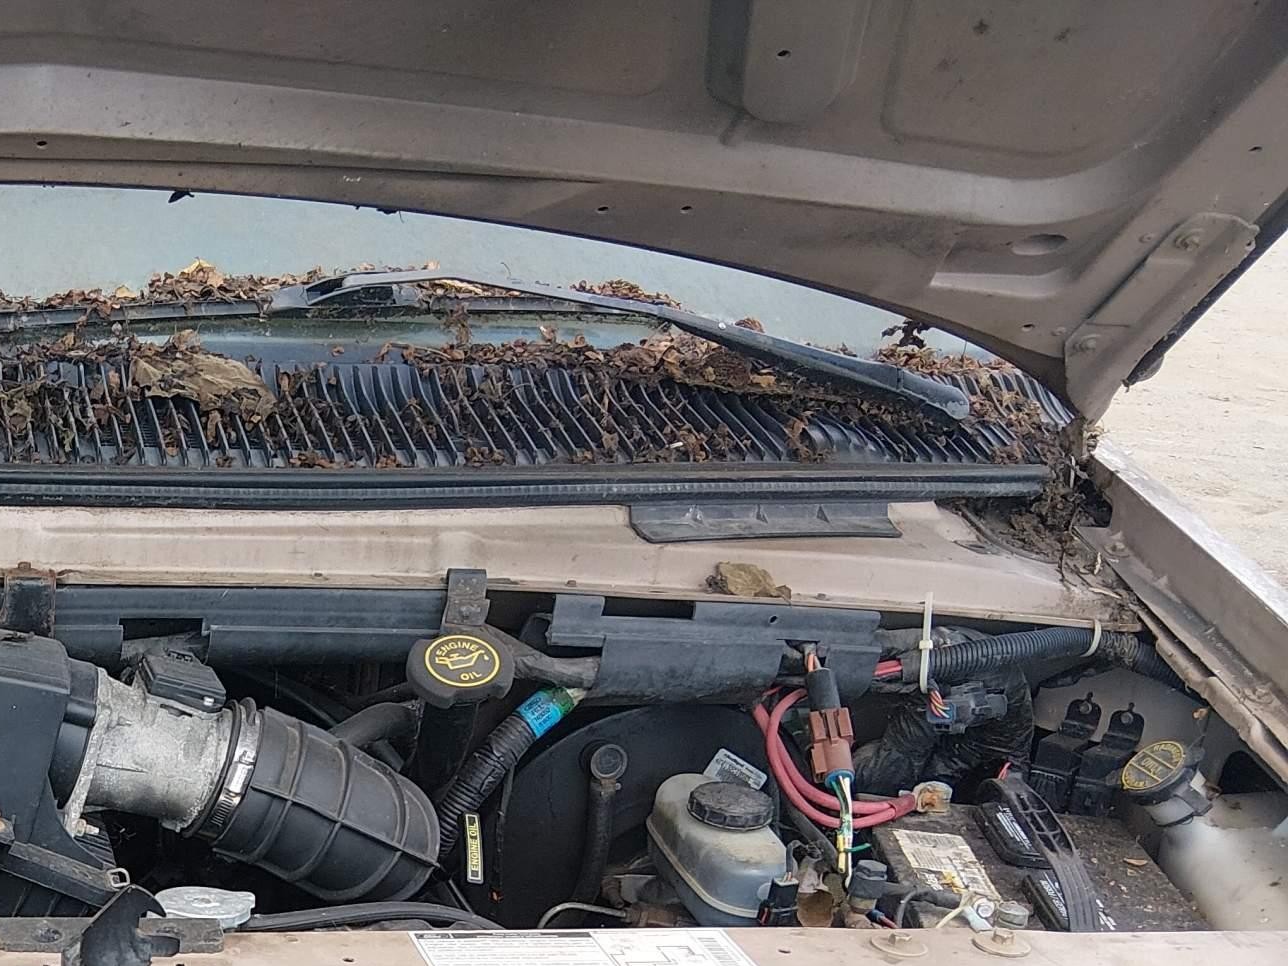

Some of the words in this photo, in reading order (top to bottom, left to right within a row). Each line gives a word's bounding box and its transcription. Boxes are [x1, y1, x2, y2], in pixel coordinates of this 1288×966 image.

[435, 641, 479, 656] ENGINE
[460, 671, 482, 681] OIL
[469, 822, 478, 838] OIL
[470, 839, 479, 871] ENGINE
